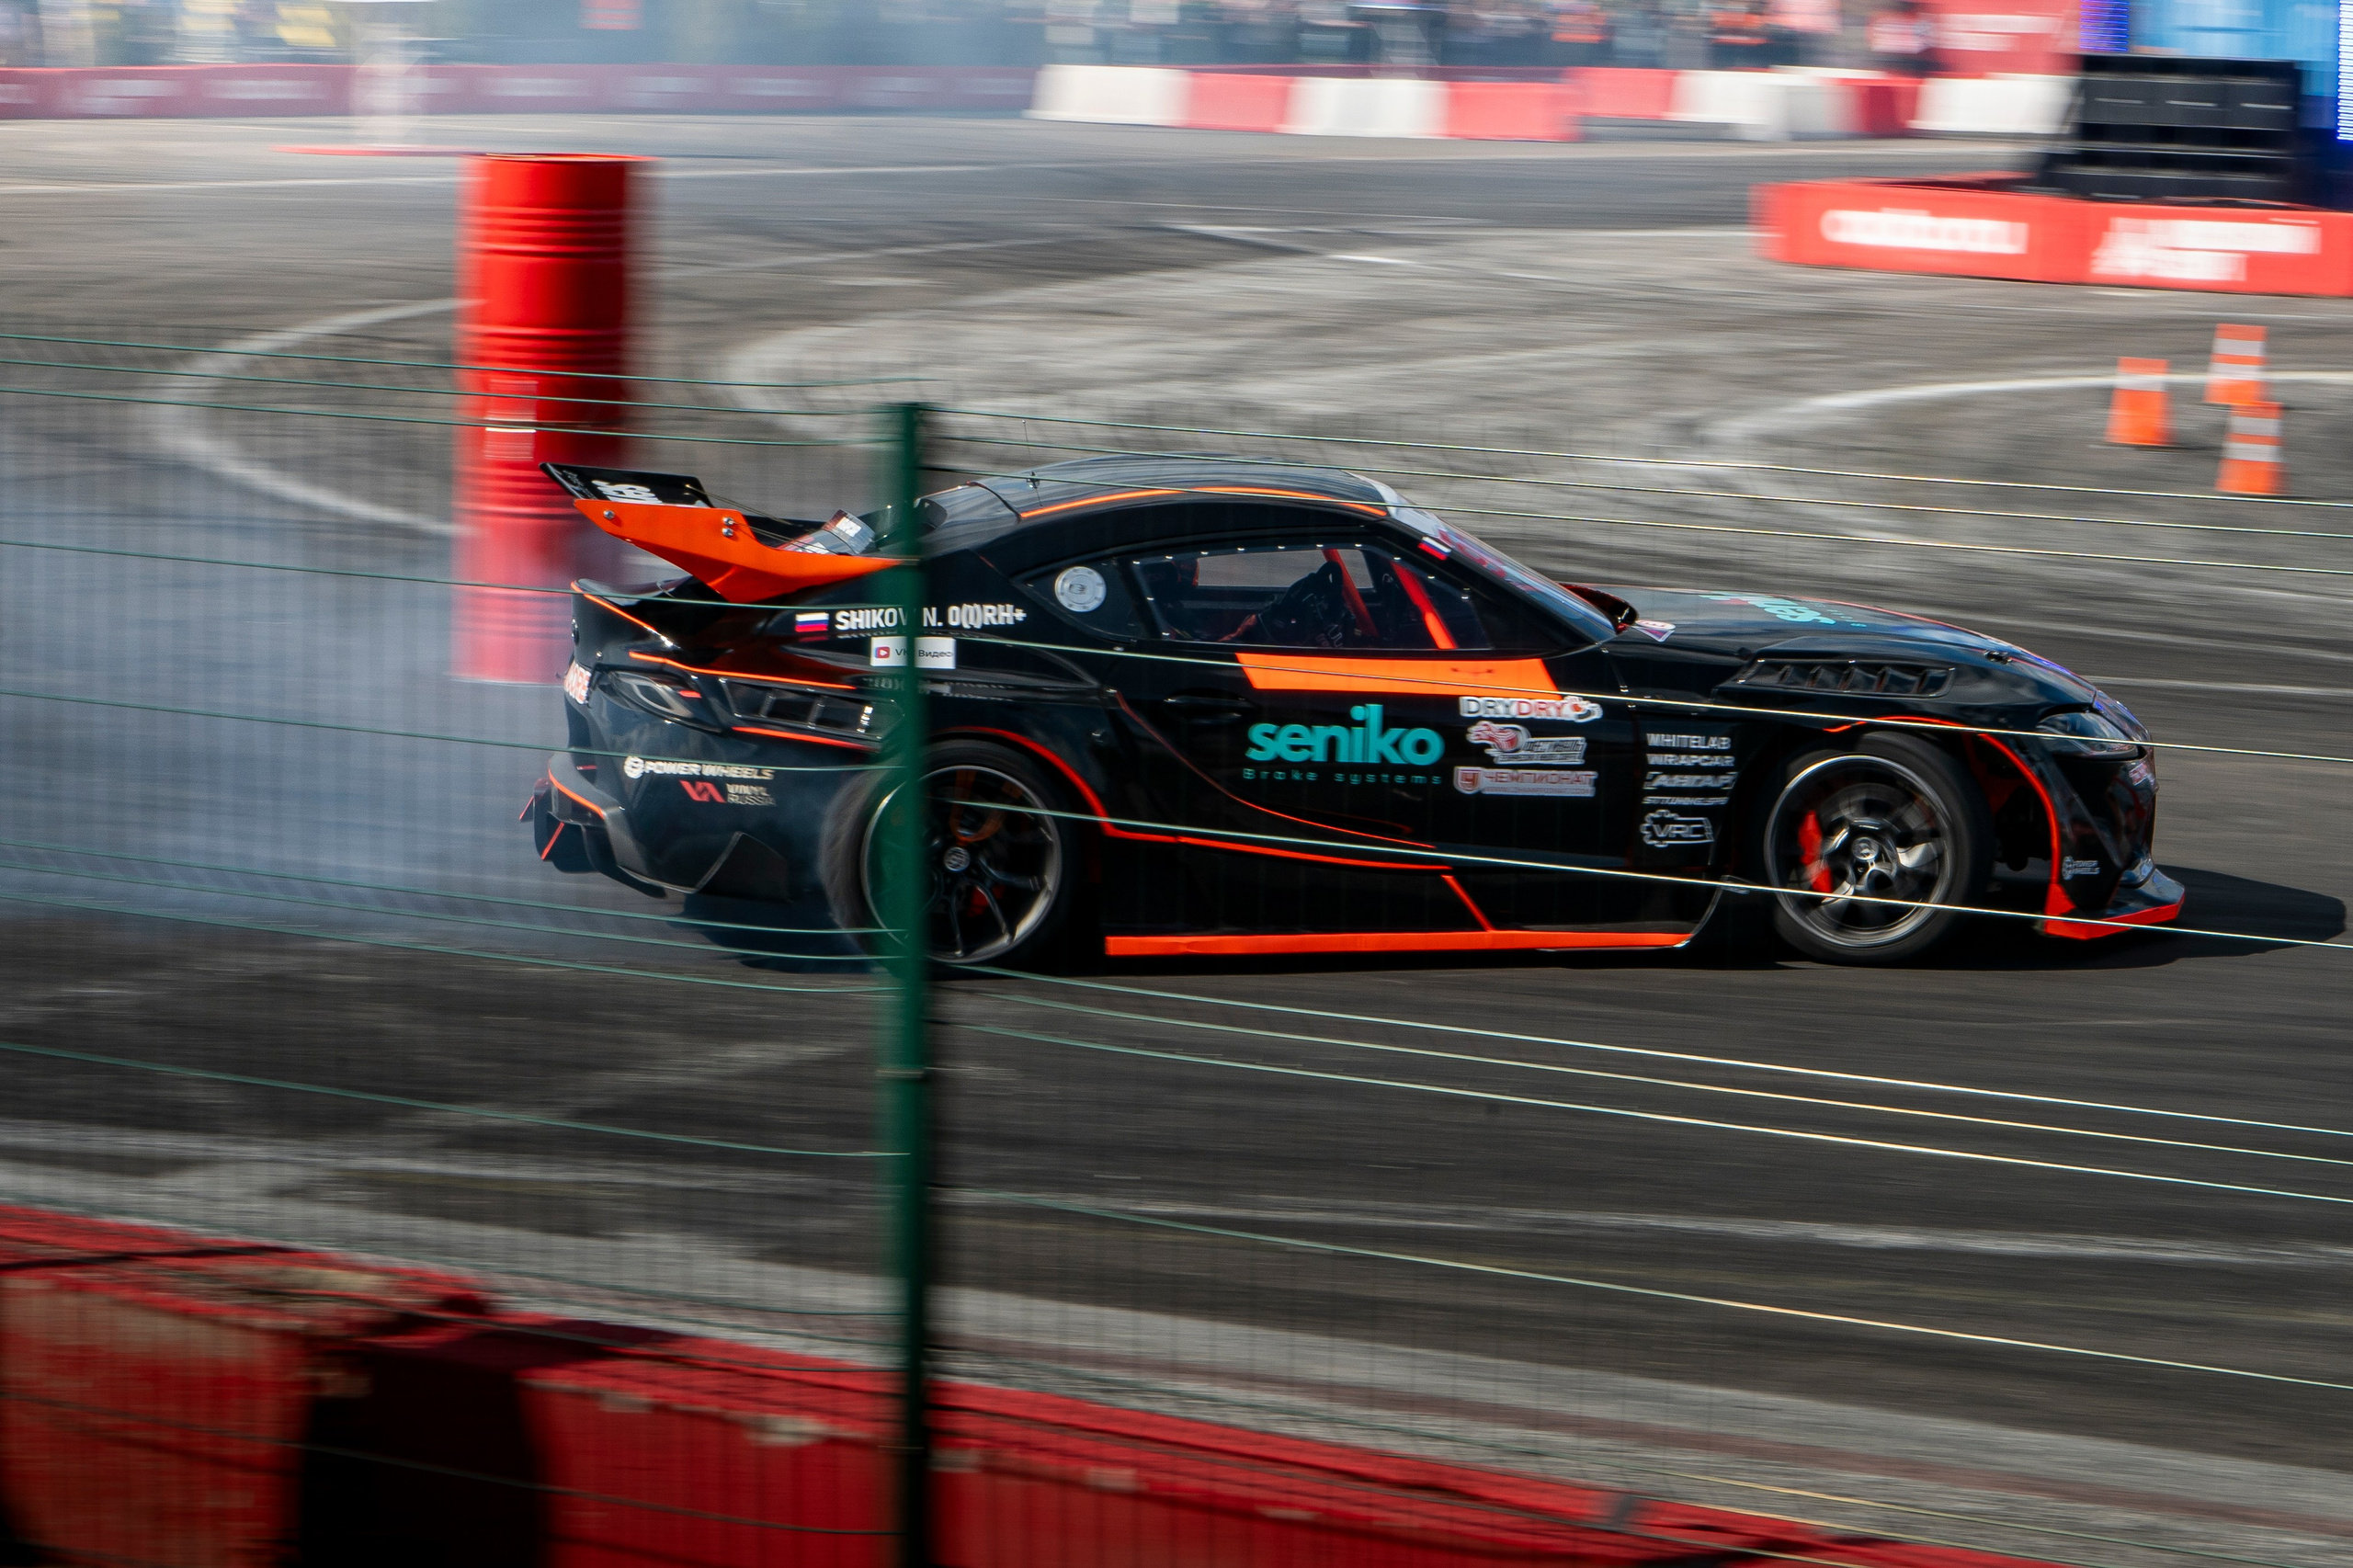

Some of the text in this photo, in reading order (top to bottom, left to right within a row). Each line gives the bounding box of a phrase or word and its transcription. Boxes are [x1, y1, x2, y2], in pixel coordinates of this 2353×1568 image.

[923, 607, 944, 627] N.
[1245, 704, 1446, 766] seniko
[644, 761, 776, 780] POWER WHEELS
[1243, 767, 1443, 785] Brake systems
